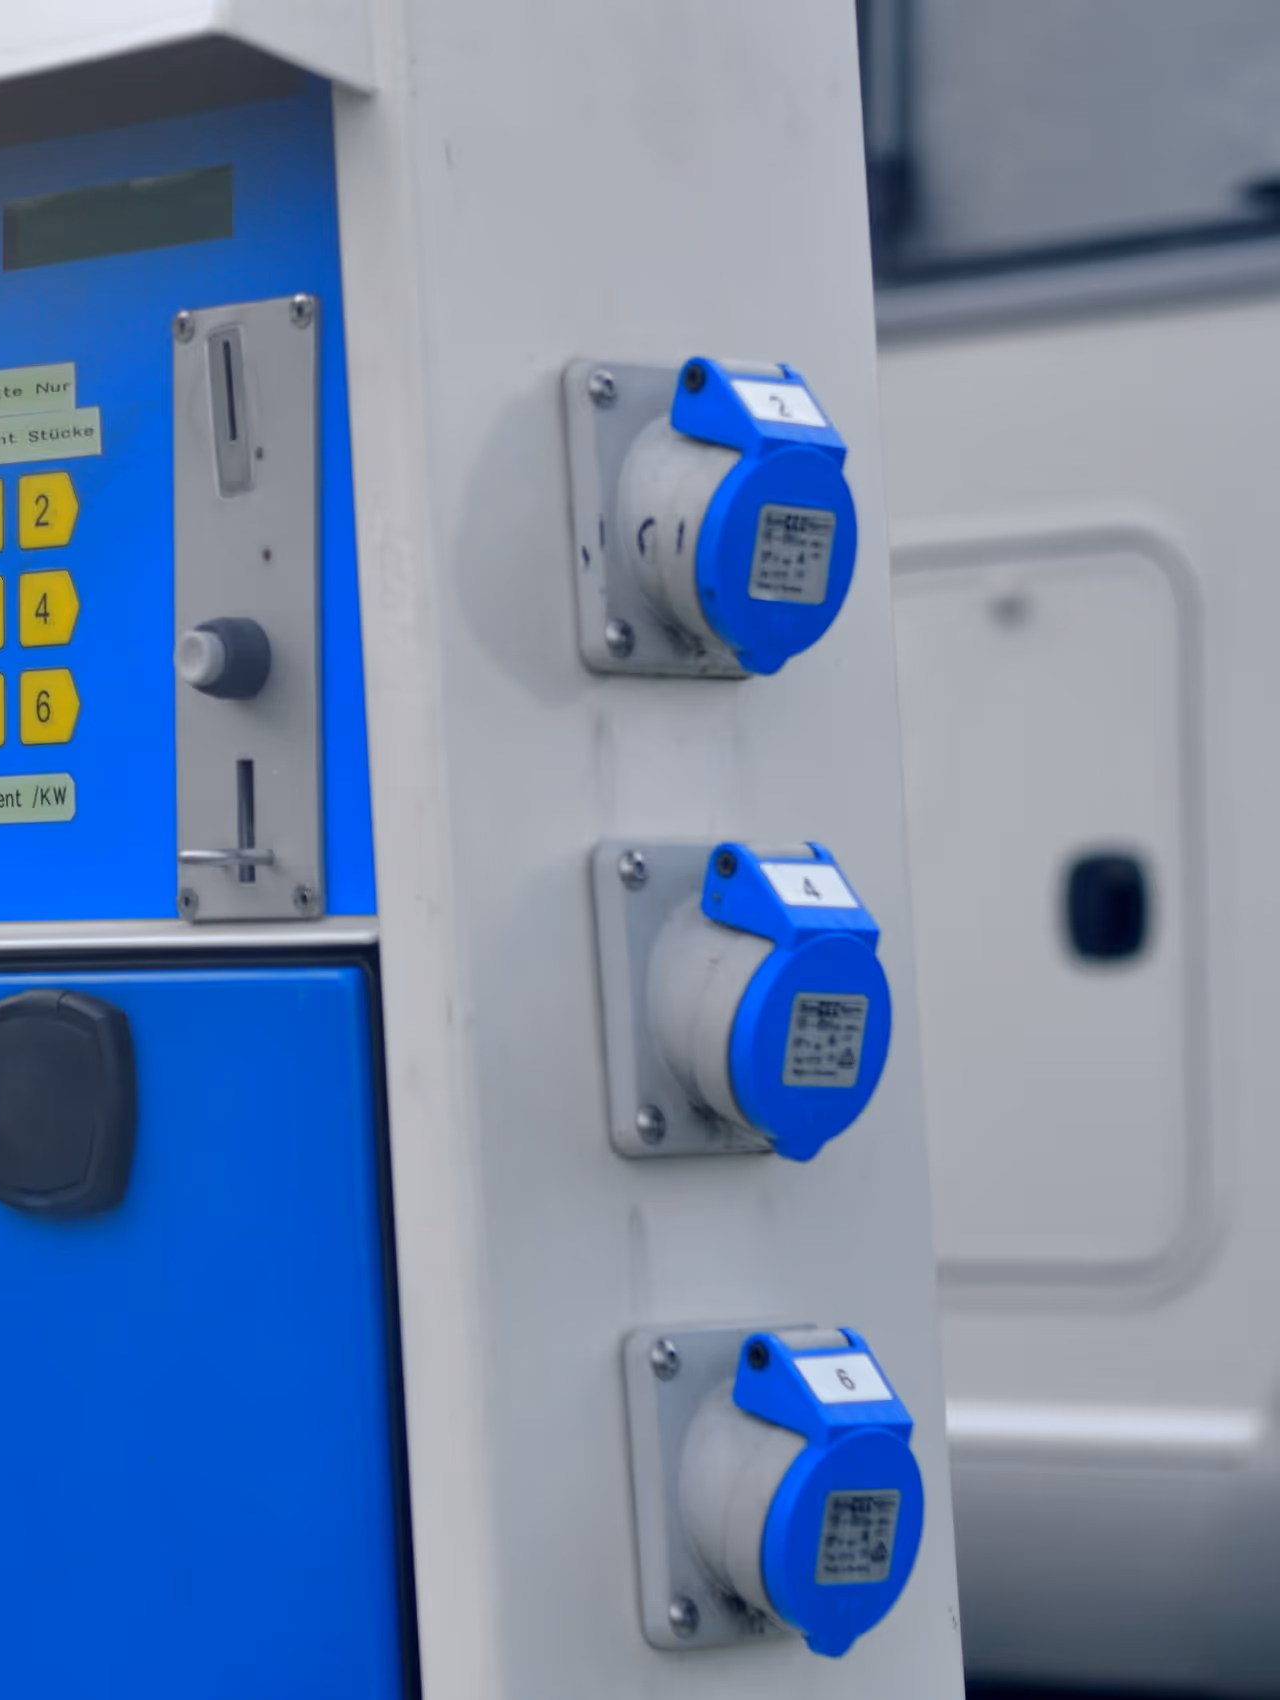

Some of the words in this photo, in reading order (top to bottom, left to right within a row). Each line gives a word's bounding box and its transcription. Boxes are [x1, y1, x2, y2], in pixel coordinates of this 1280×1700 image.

[35, 382, 72, 395] Nur
[769, 394, 793, 419] 2
[27, 425, 95, 443] Stücke
[34, 494, 50, 528] 2
[34, 592, 50, 625] 4
[35, 689, 51, 723] 6
[31, 785, 68, 809] /KW
[803, 876, 823, 900] 4
[835, 1367, 856, 1391] 6
